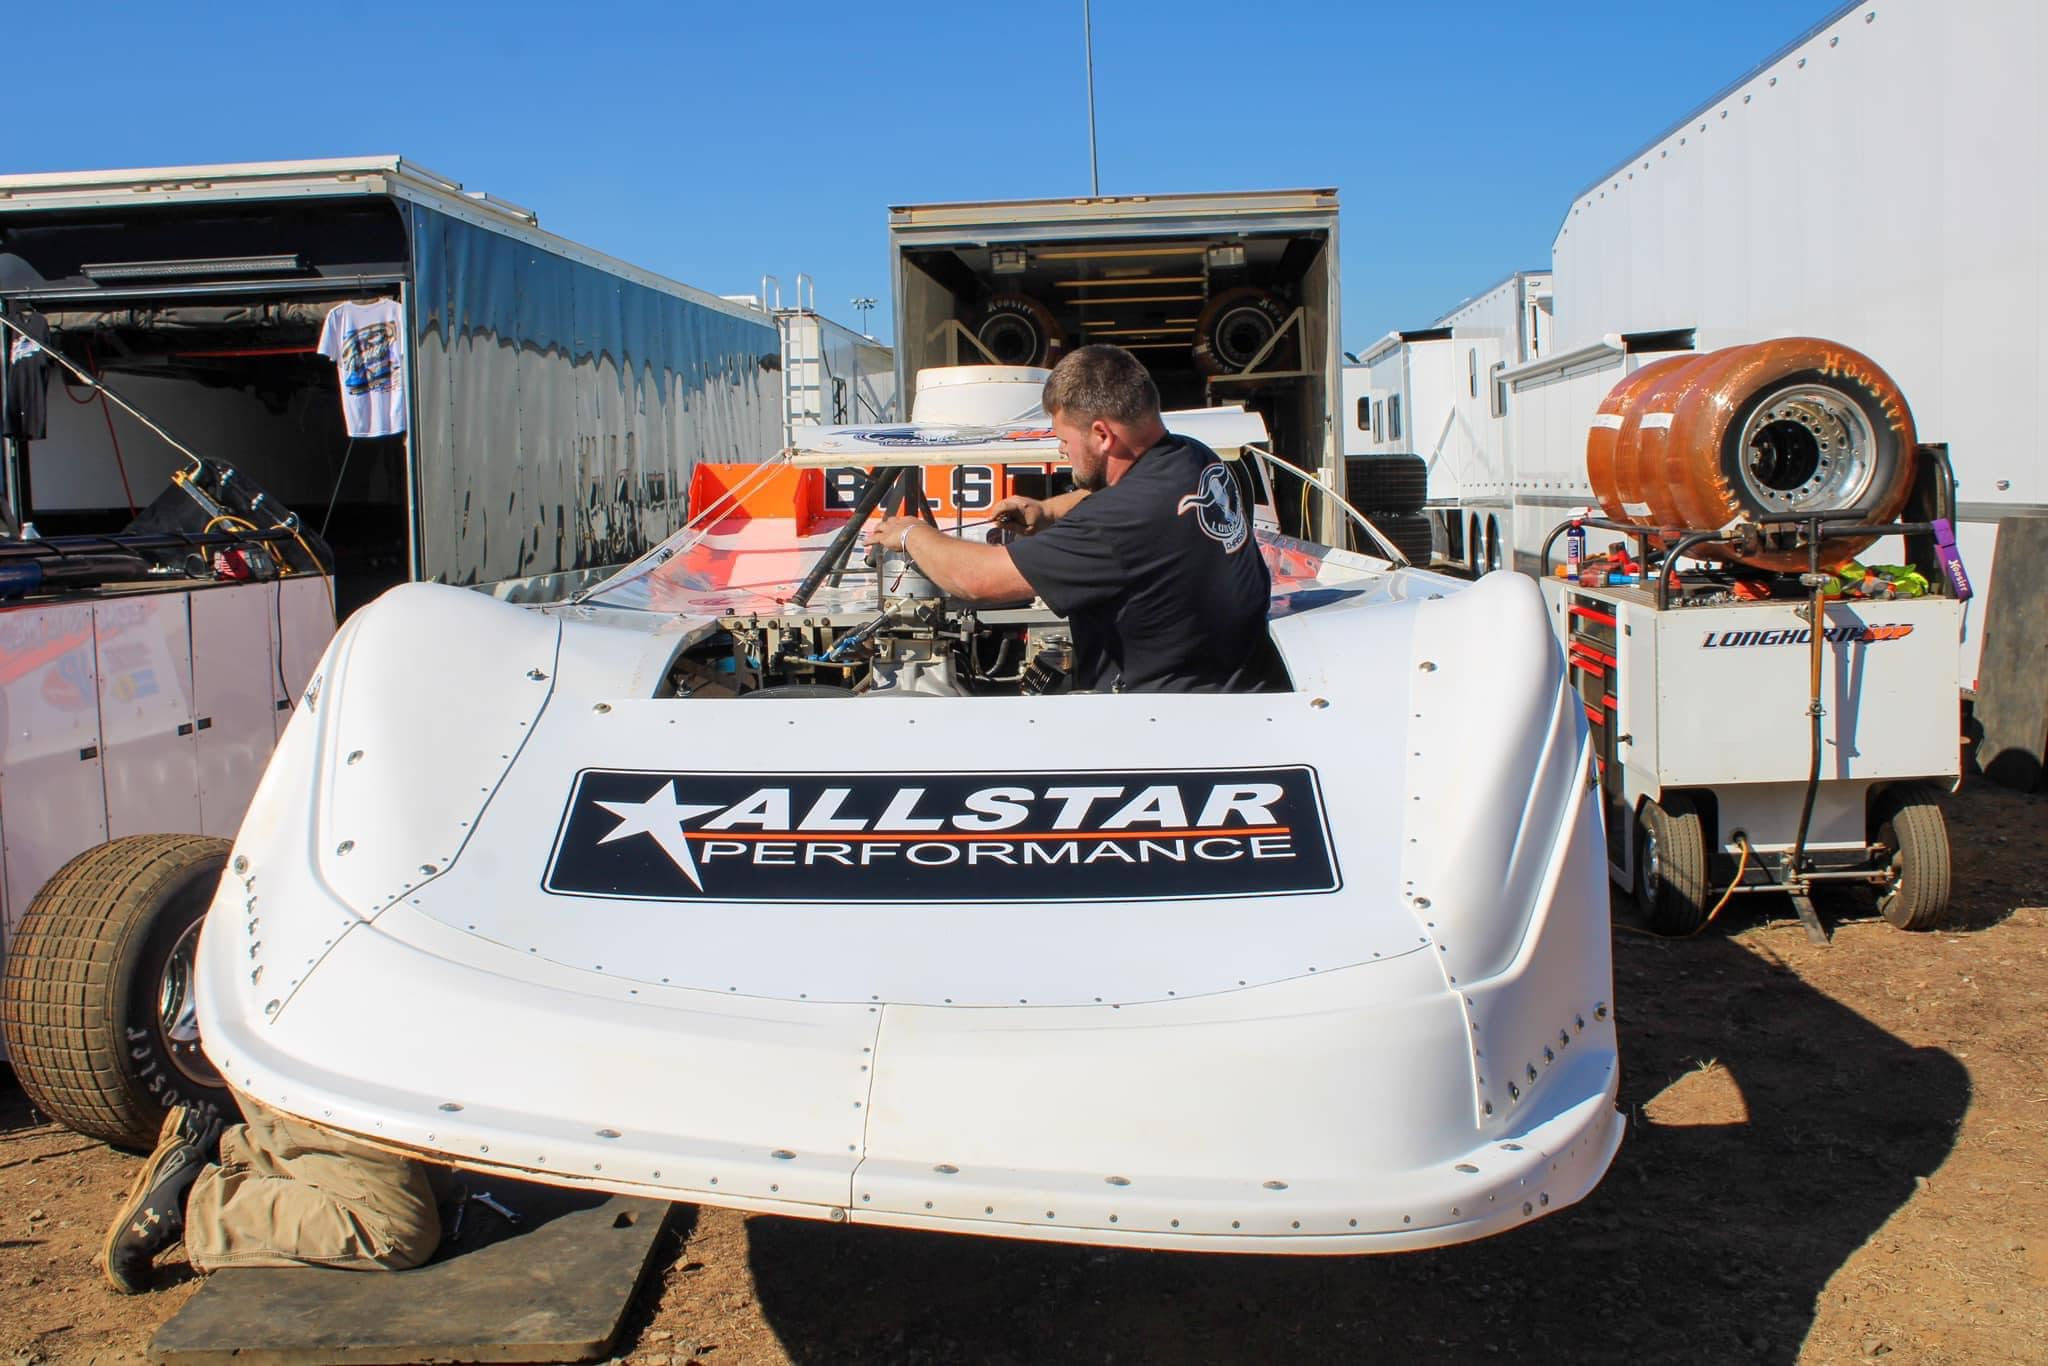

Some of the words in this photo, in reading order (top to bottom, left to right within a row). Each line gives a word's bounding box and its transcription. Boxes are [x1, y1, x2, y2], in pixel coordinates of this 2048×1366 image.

[1818, 351, 1904, 431] Hoosier
[700, 783, 1285, 831] ALLSTAR
[700, 835, 1297, 865] PERFORMANCE
